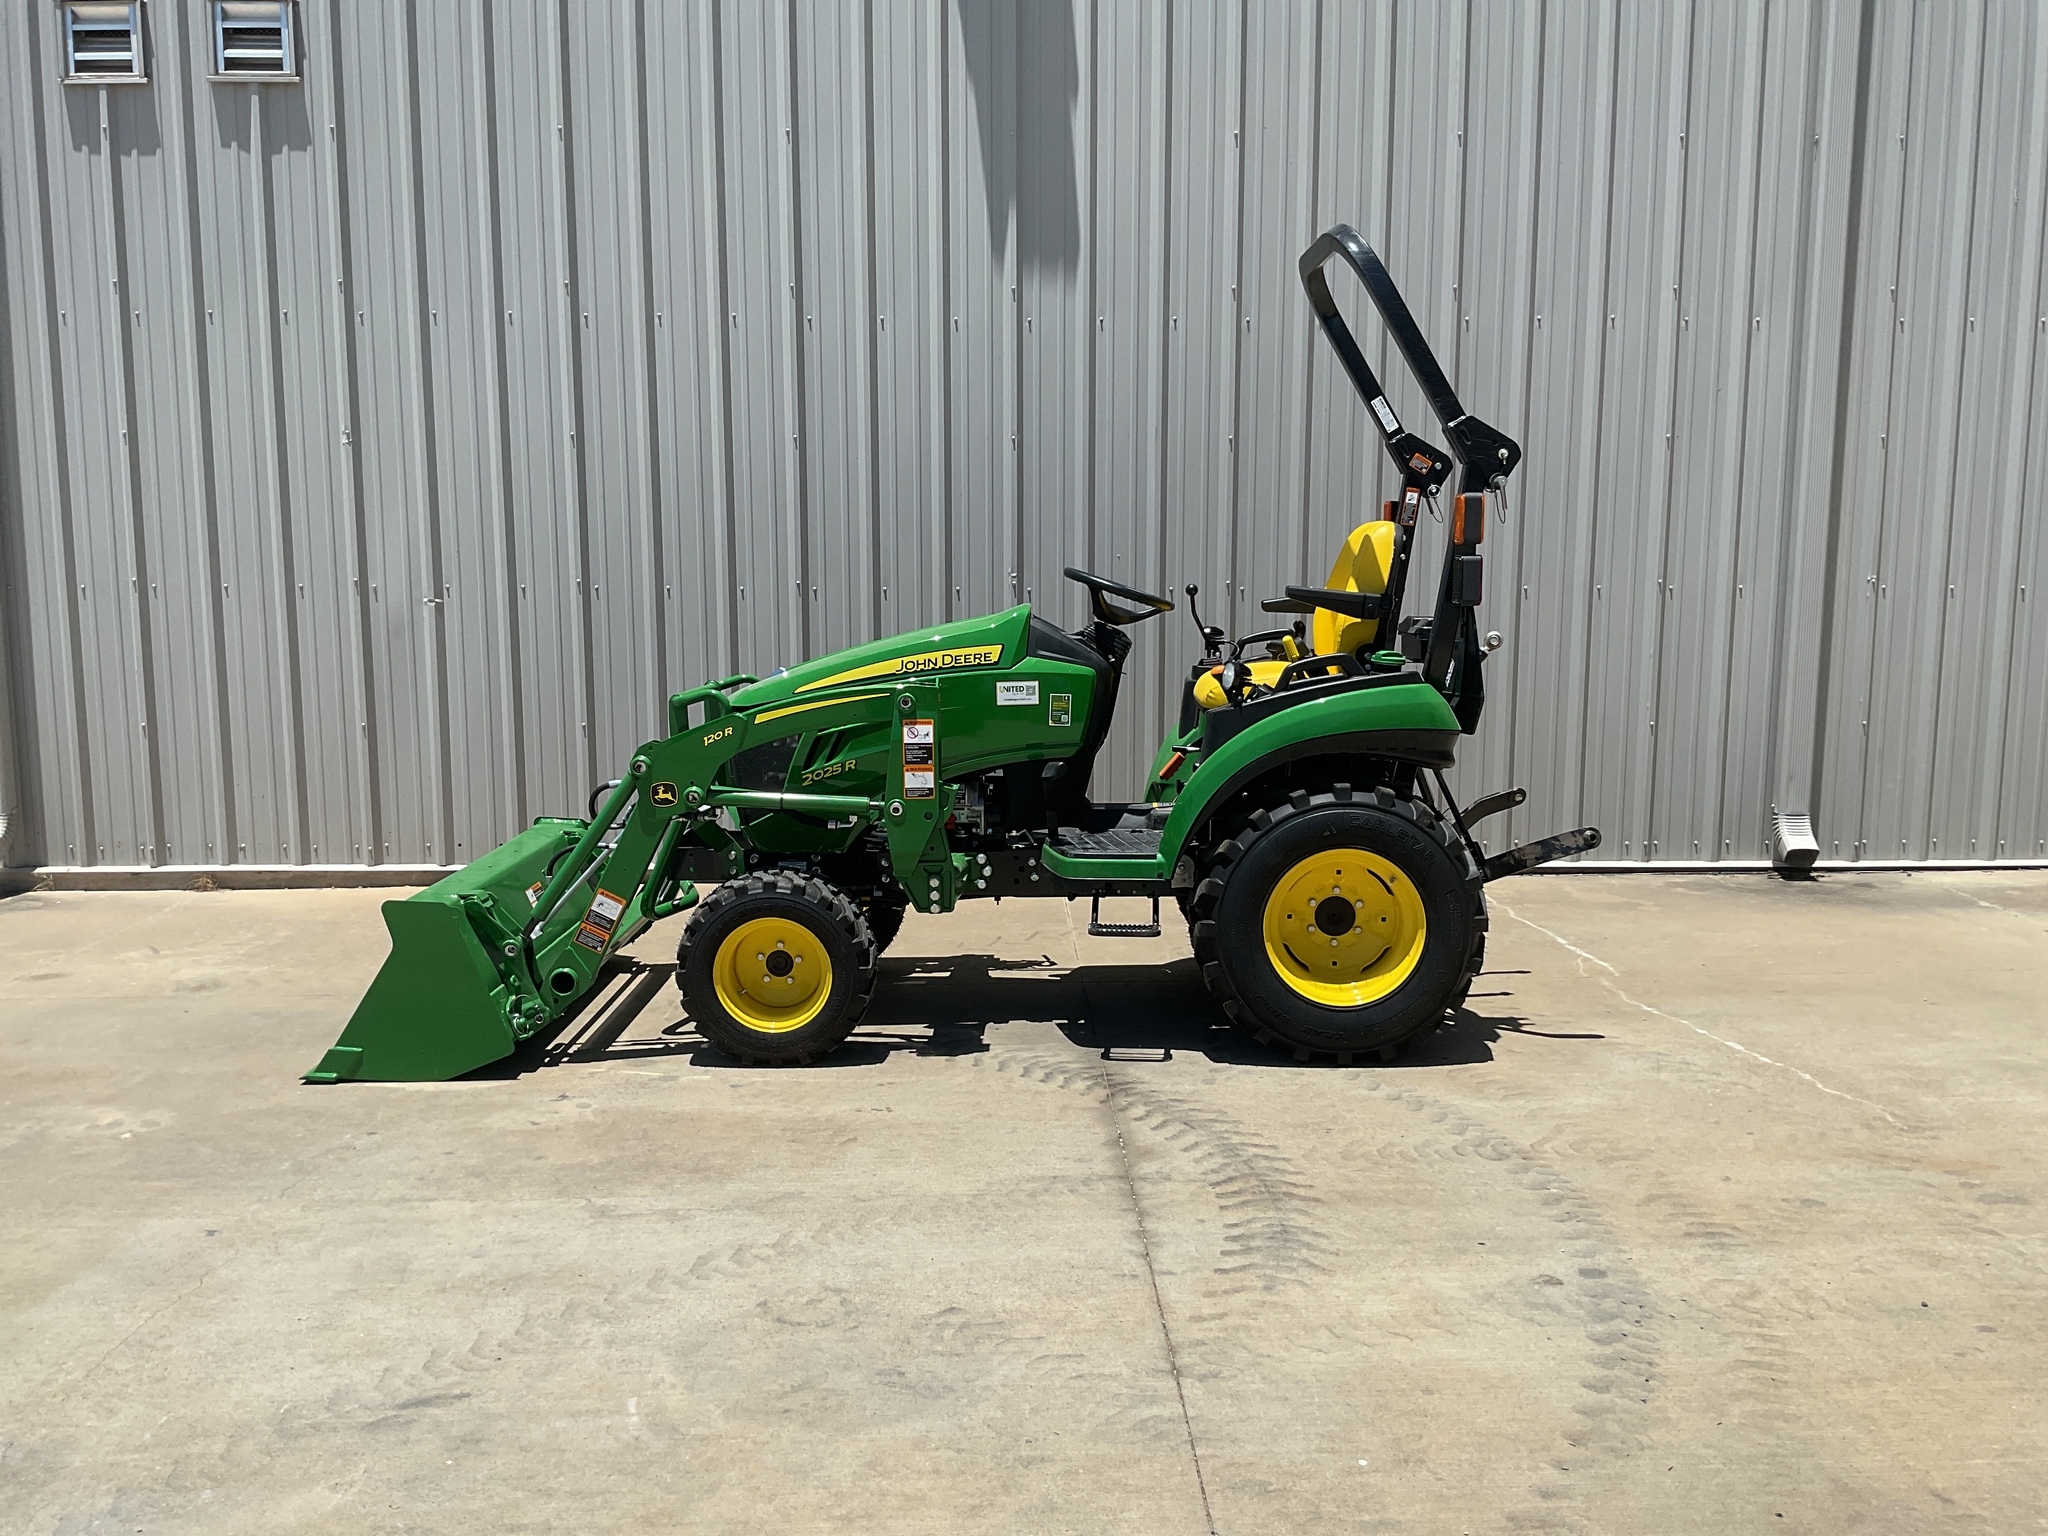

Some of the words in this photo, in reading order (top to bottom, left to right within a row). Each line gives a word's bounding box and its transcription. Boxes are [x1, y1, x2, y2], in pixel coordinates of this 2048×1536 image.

[895, 657, 938, 673] JOHN
[941, 652, 993, 667] DEERE
[999, 685, 1025, 693] UNITED
[702, 730, 723, 747] 120
[724, 726, 733, 738] R
[801, 763, 842, 787] 2025
[845, 759, 857, 772] R
[1349, 813, 1438, 866] CARLSTAR
